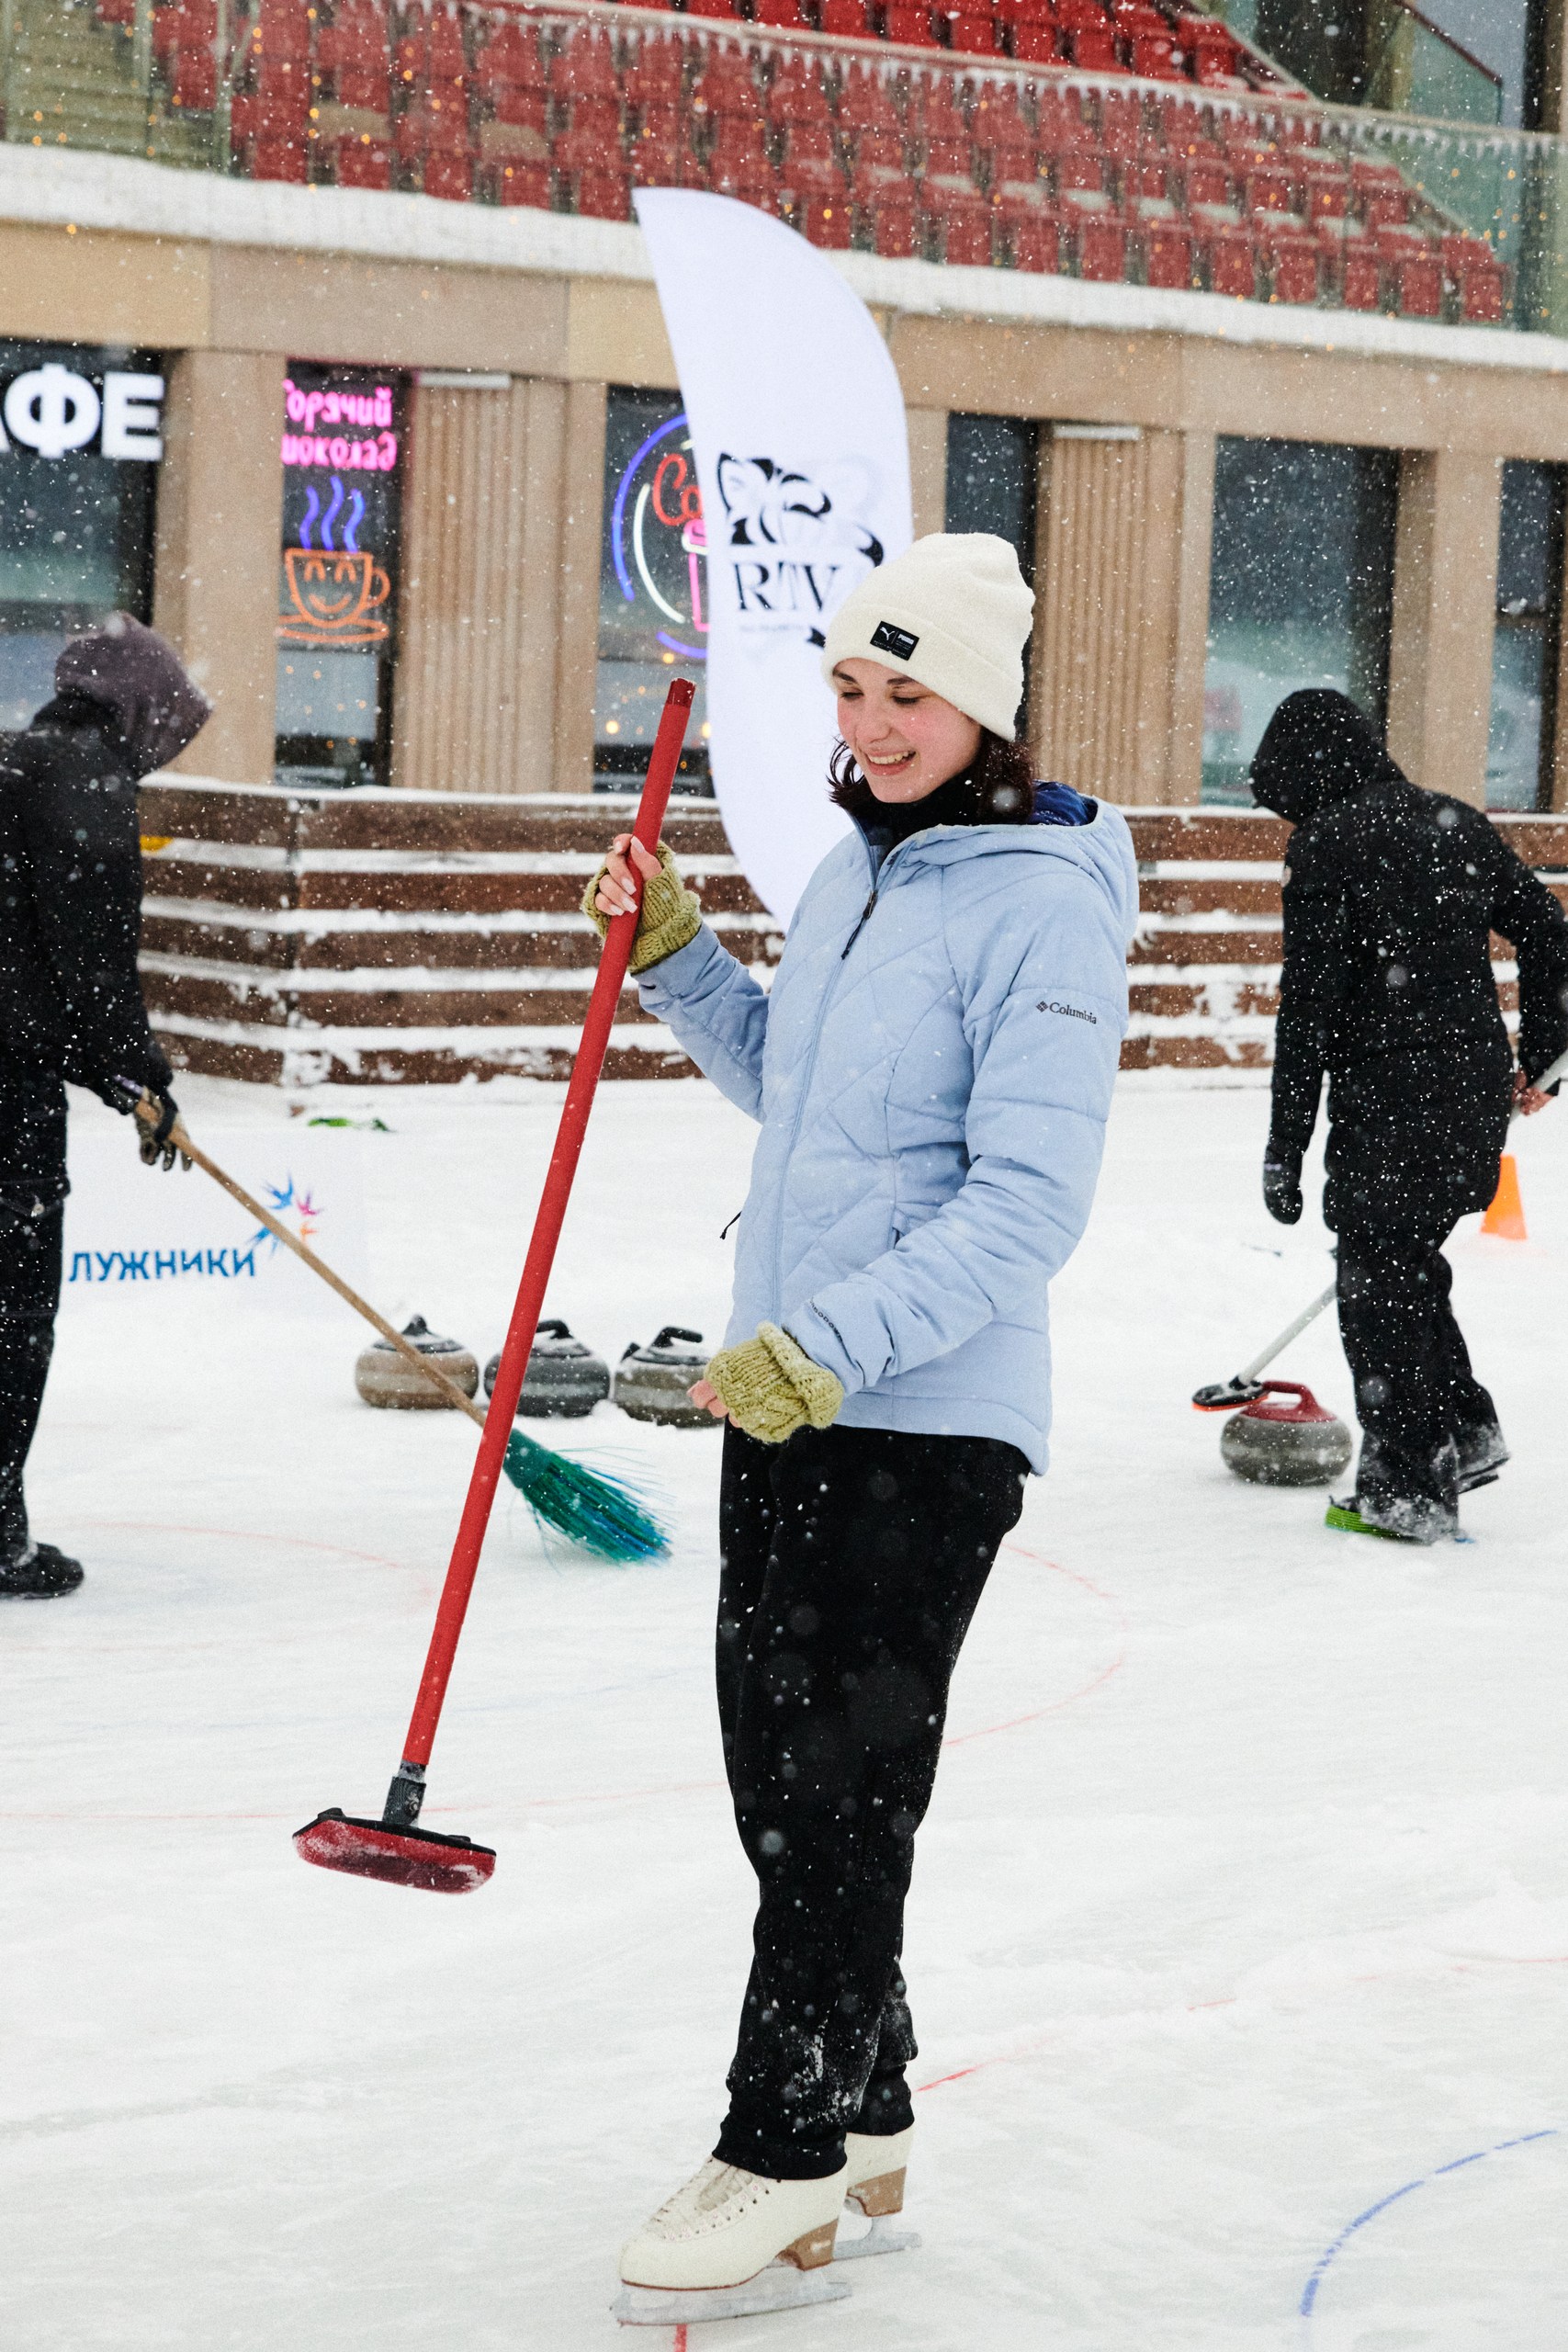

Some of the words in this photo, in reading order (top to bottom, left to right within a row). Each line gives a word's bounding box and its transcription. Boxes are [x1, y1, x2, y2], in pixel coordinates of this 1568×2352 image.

[0, 363, 164, 461] ФЕ
[1049, 1001, 1098, 1025] Columbia
[68, 1249, 255, 1283] ЛУЖНИКИ
